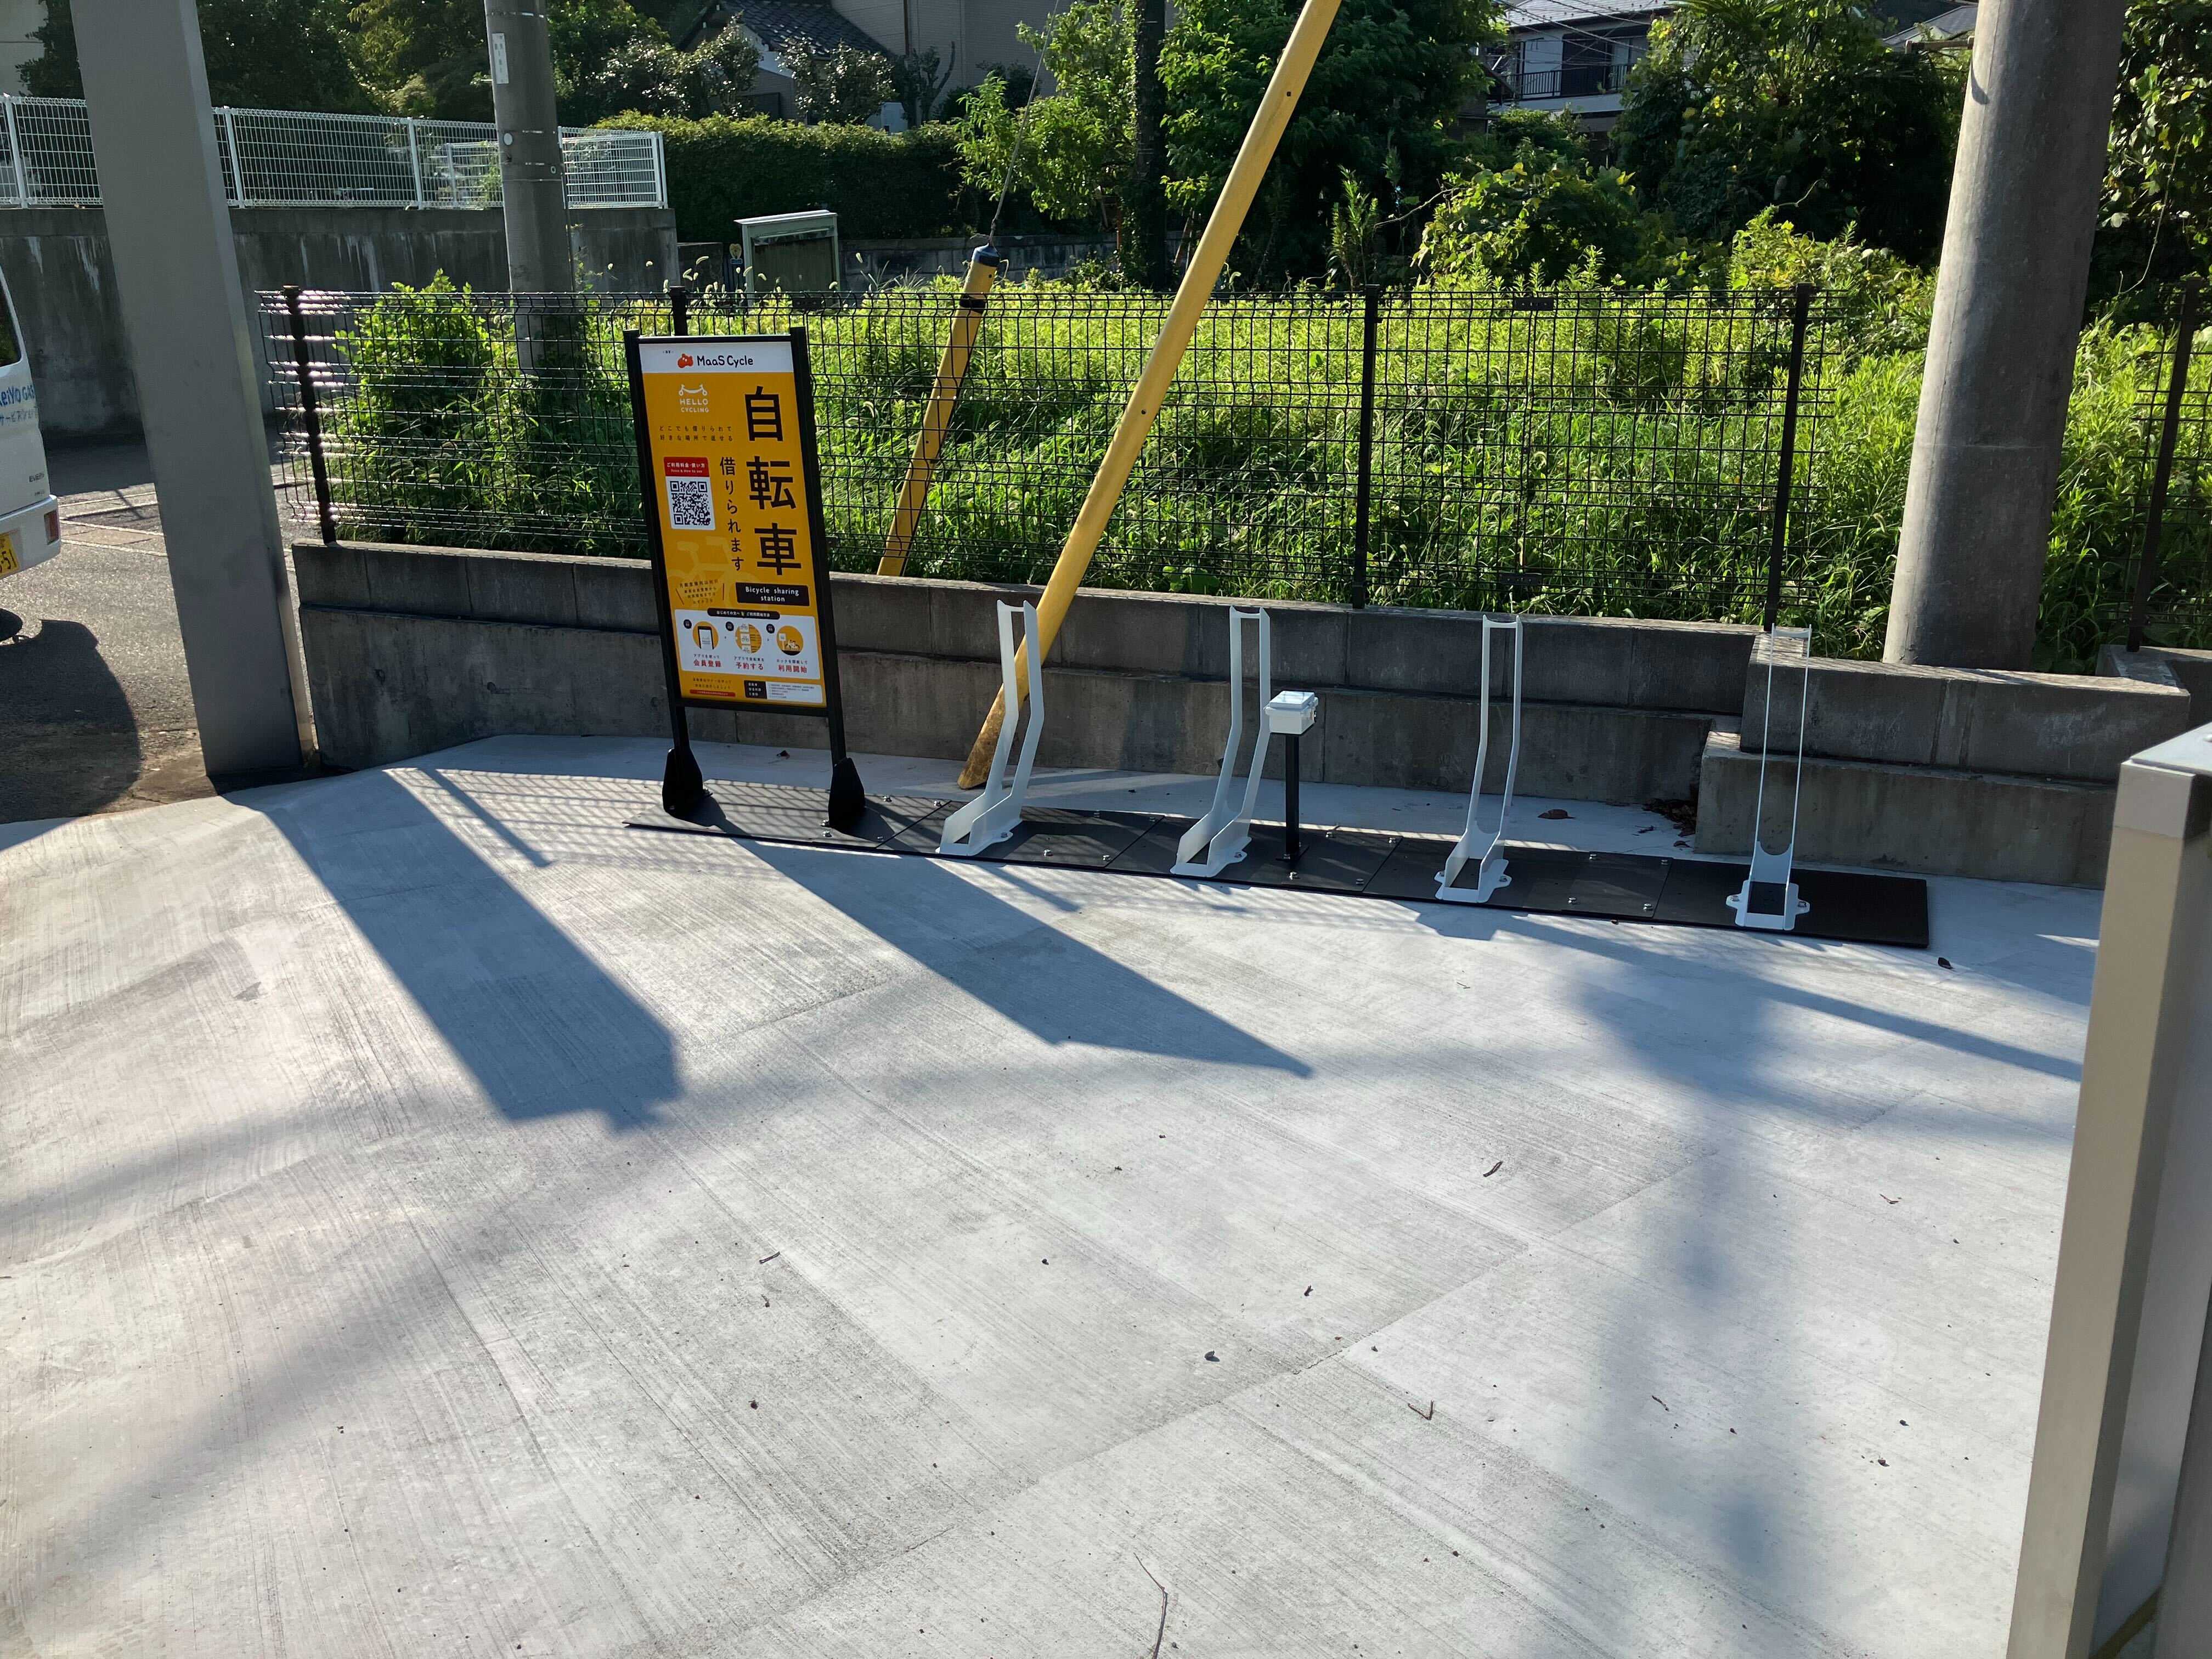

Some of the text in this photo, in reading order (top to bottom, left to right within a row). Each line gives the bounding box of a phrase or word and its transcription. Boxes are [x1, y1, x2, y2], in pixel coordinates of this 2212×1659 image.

[697, 355, 753, 368] MaaS Cycle
[744, 386, 802, 576] 自転車
[720, 456, 744, 571] 借りられます
[774, 587, 799, 596] sharing
[693, 659, 721, 668] 会員登録
[736, 662, 764, 670] 予約する
[778, 664, 807, 673] 利用開始
